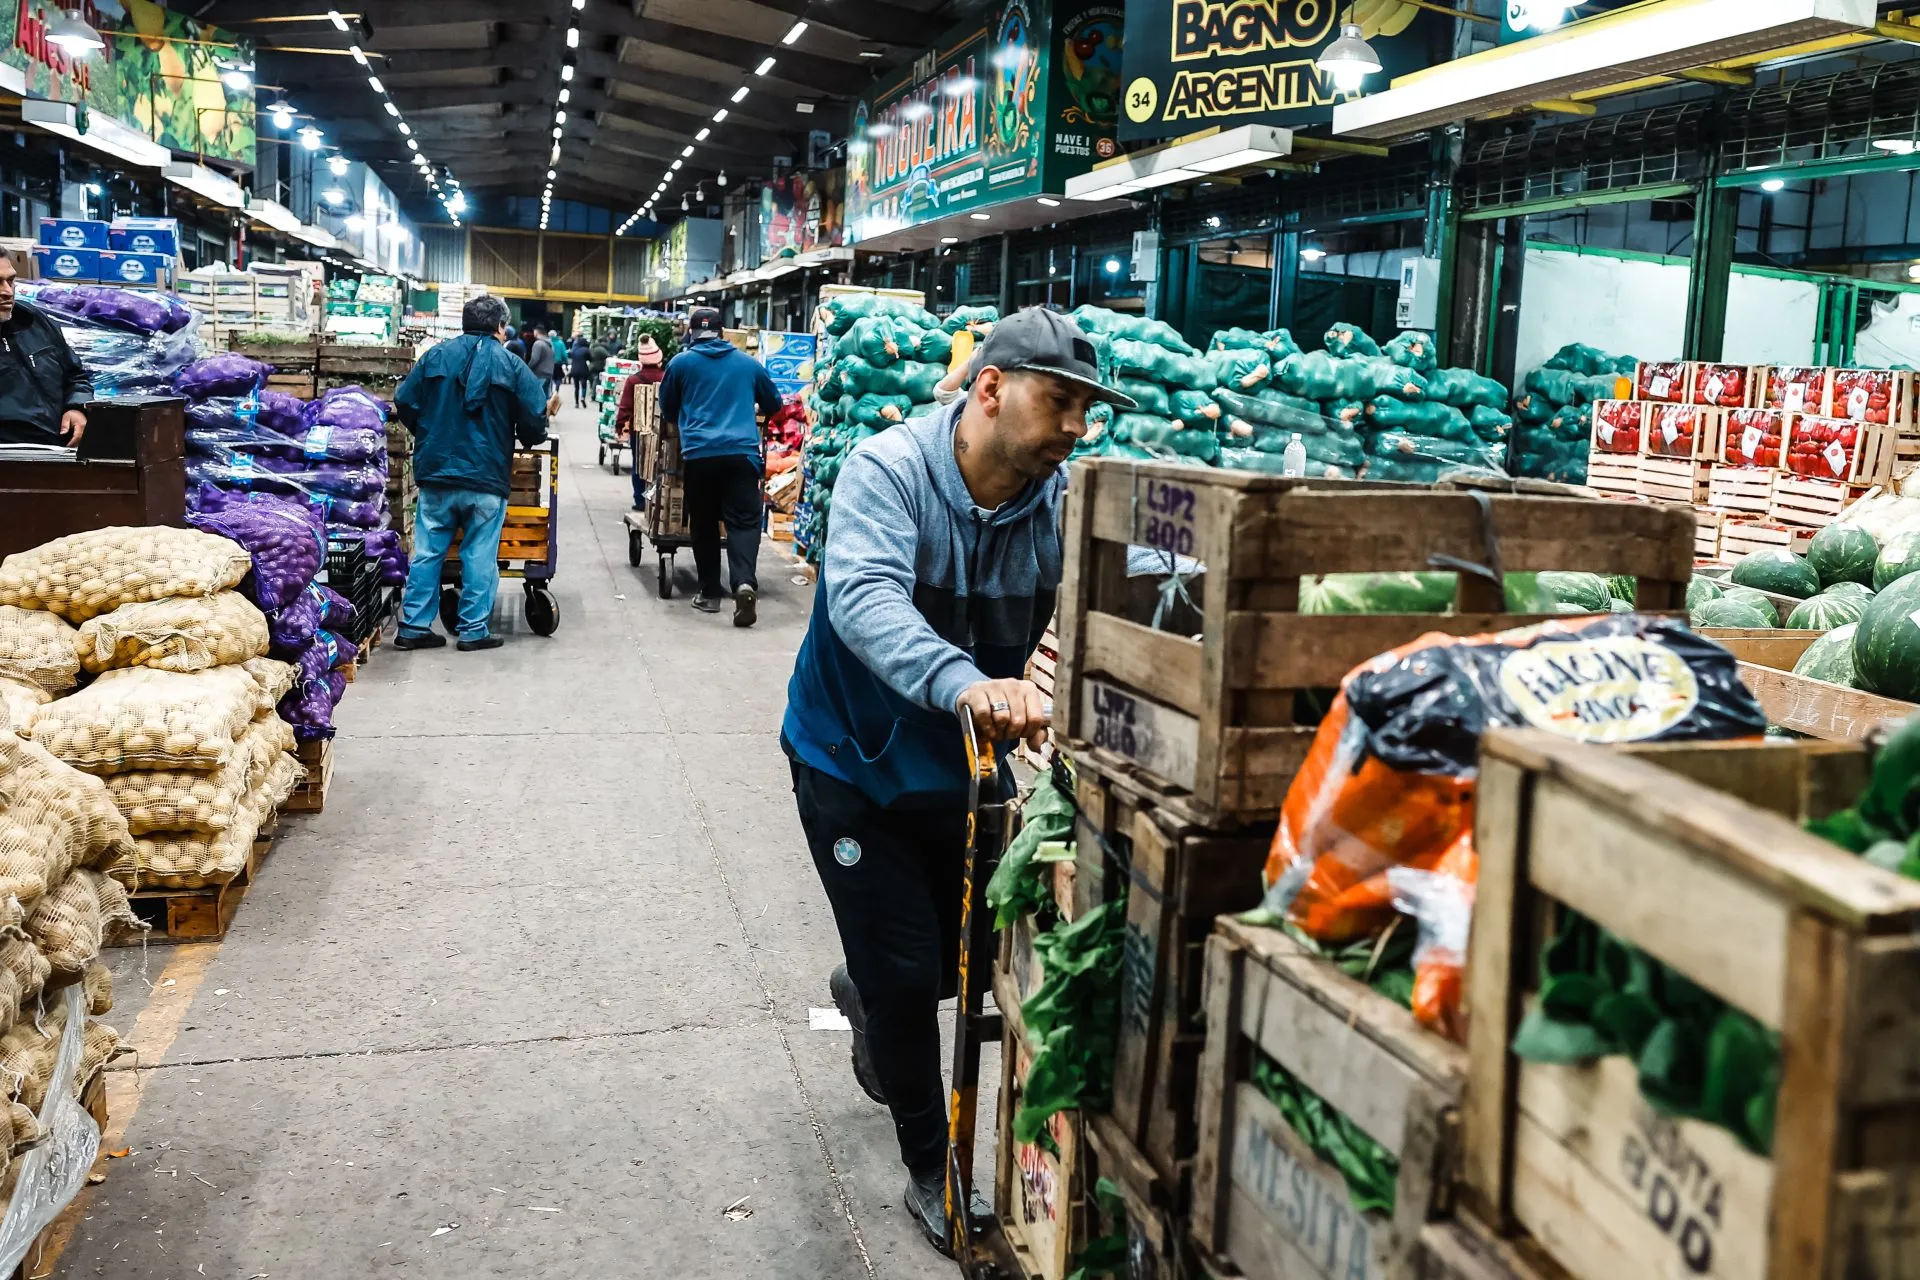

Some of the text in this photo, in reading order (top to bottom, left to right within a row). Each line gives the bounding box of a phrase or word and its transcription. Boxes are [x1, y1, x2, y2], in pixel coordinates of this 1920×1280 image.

[1171, 0, 1336, 62] BAGNO
[1131, 91, 1151, 108] 34
[1055, 133, 1083, 146] NAVE
[1054, 144, 1090, 156] PUESTOS
[1099, 142, 1112, 153] 36
